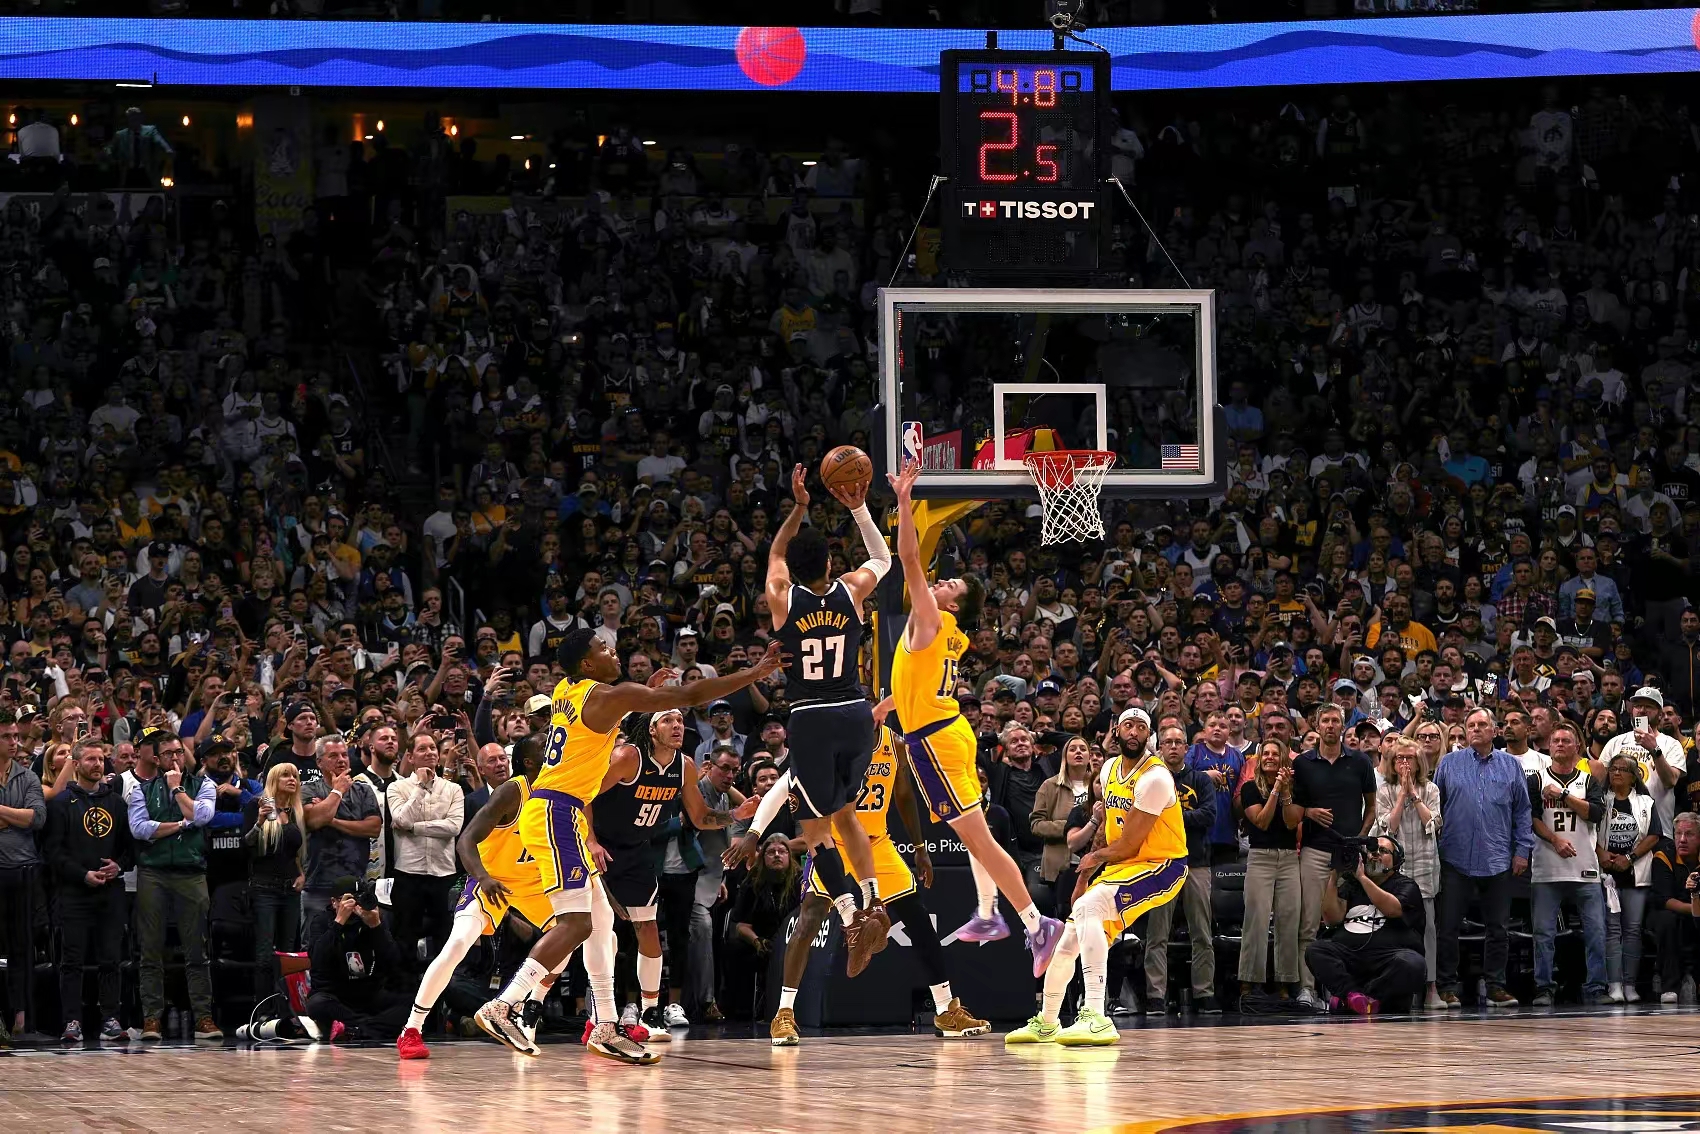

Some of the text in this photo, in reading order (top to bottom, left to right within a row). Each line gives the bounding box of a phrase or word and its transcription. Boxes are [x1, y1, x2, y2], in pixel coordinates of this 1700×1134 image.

[997, 70, 1056, 107] 4.8
[979, 112, 1058, 181] 2.5
[1000, 201, 1094, 219] TISSOT
[795, 610, 850, 634] MURRAY
[801, 634, 846, 680] 27
[635, 785, 677, 801] DENVER
[855, 783, 886, 812] 23
[634, 803, 663, 827] 50
[1553, 811, 1577, 832] 27
[212, 836, 241, 850] NUGG
[892, 839, 969, 854] oole Pixe
